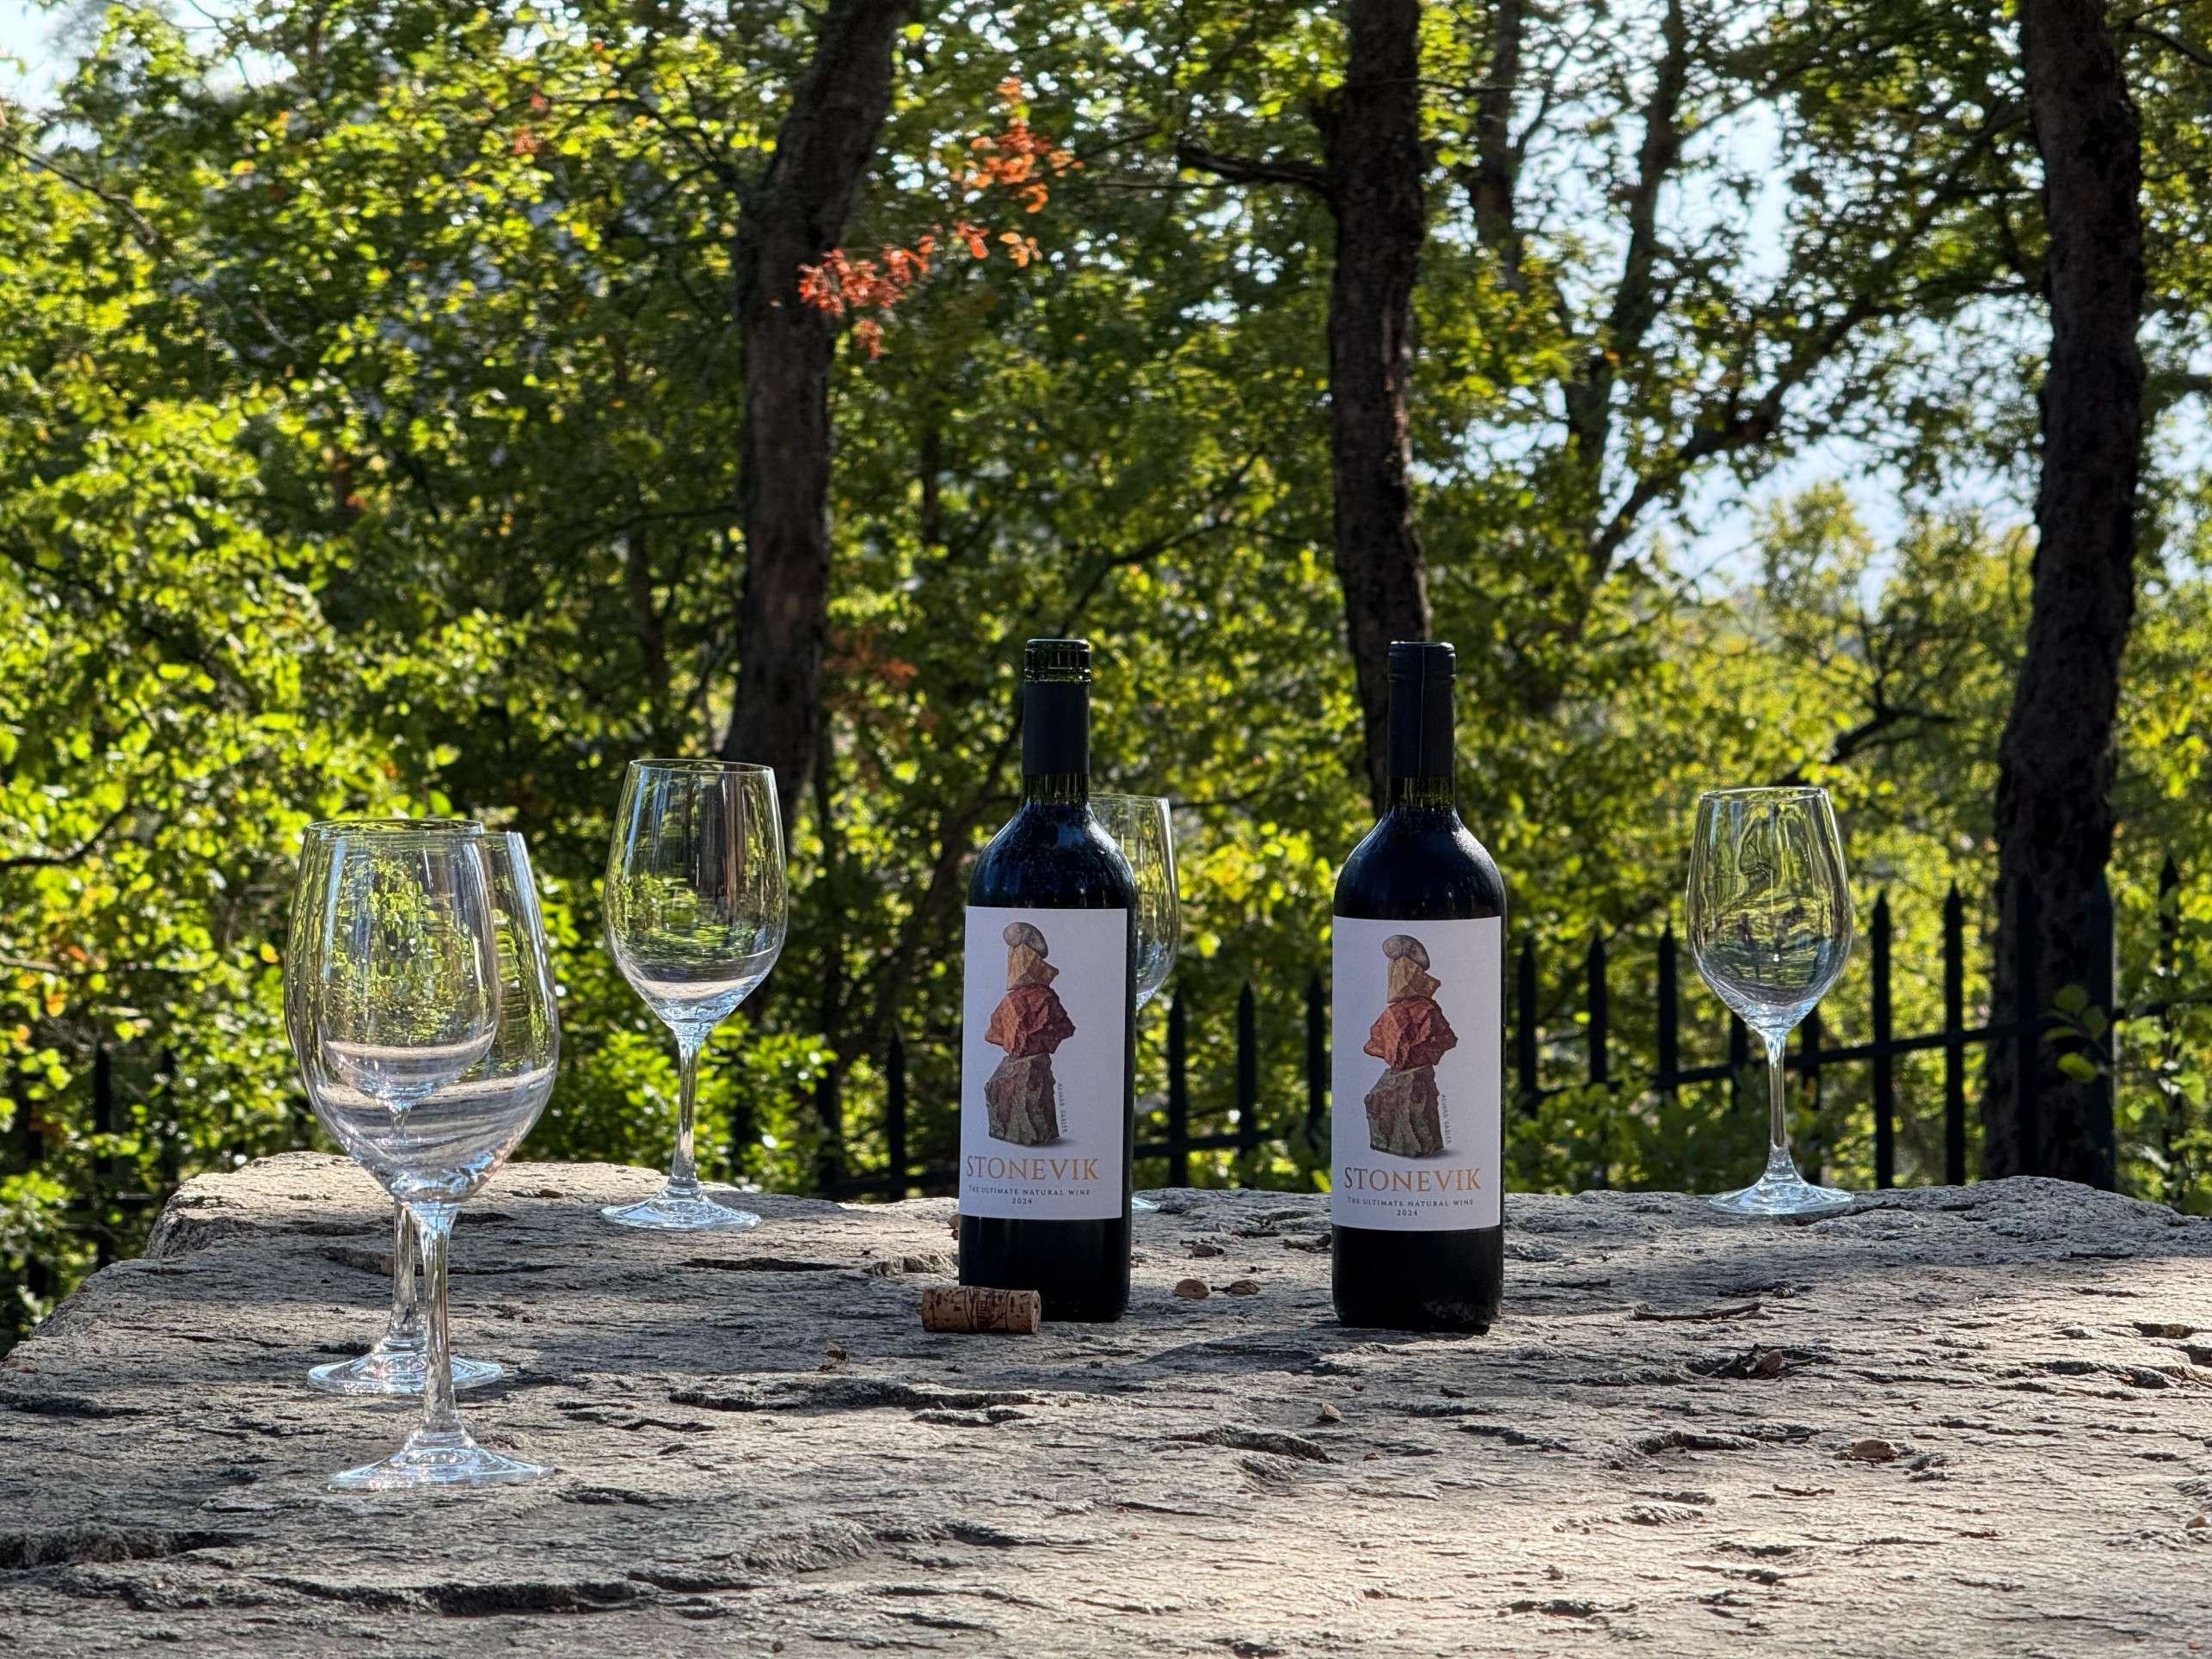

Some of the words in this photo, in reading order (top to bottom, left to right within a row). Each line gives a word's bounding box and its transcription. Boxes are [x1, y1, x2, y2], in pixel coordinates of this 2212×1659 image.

[967, 1155, 1099, 1181] STONEVIK
[1344, 1166, 1481, 1193] STONEVIK
[1363, 1198, 1404, 1207] ULTIMATE
